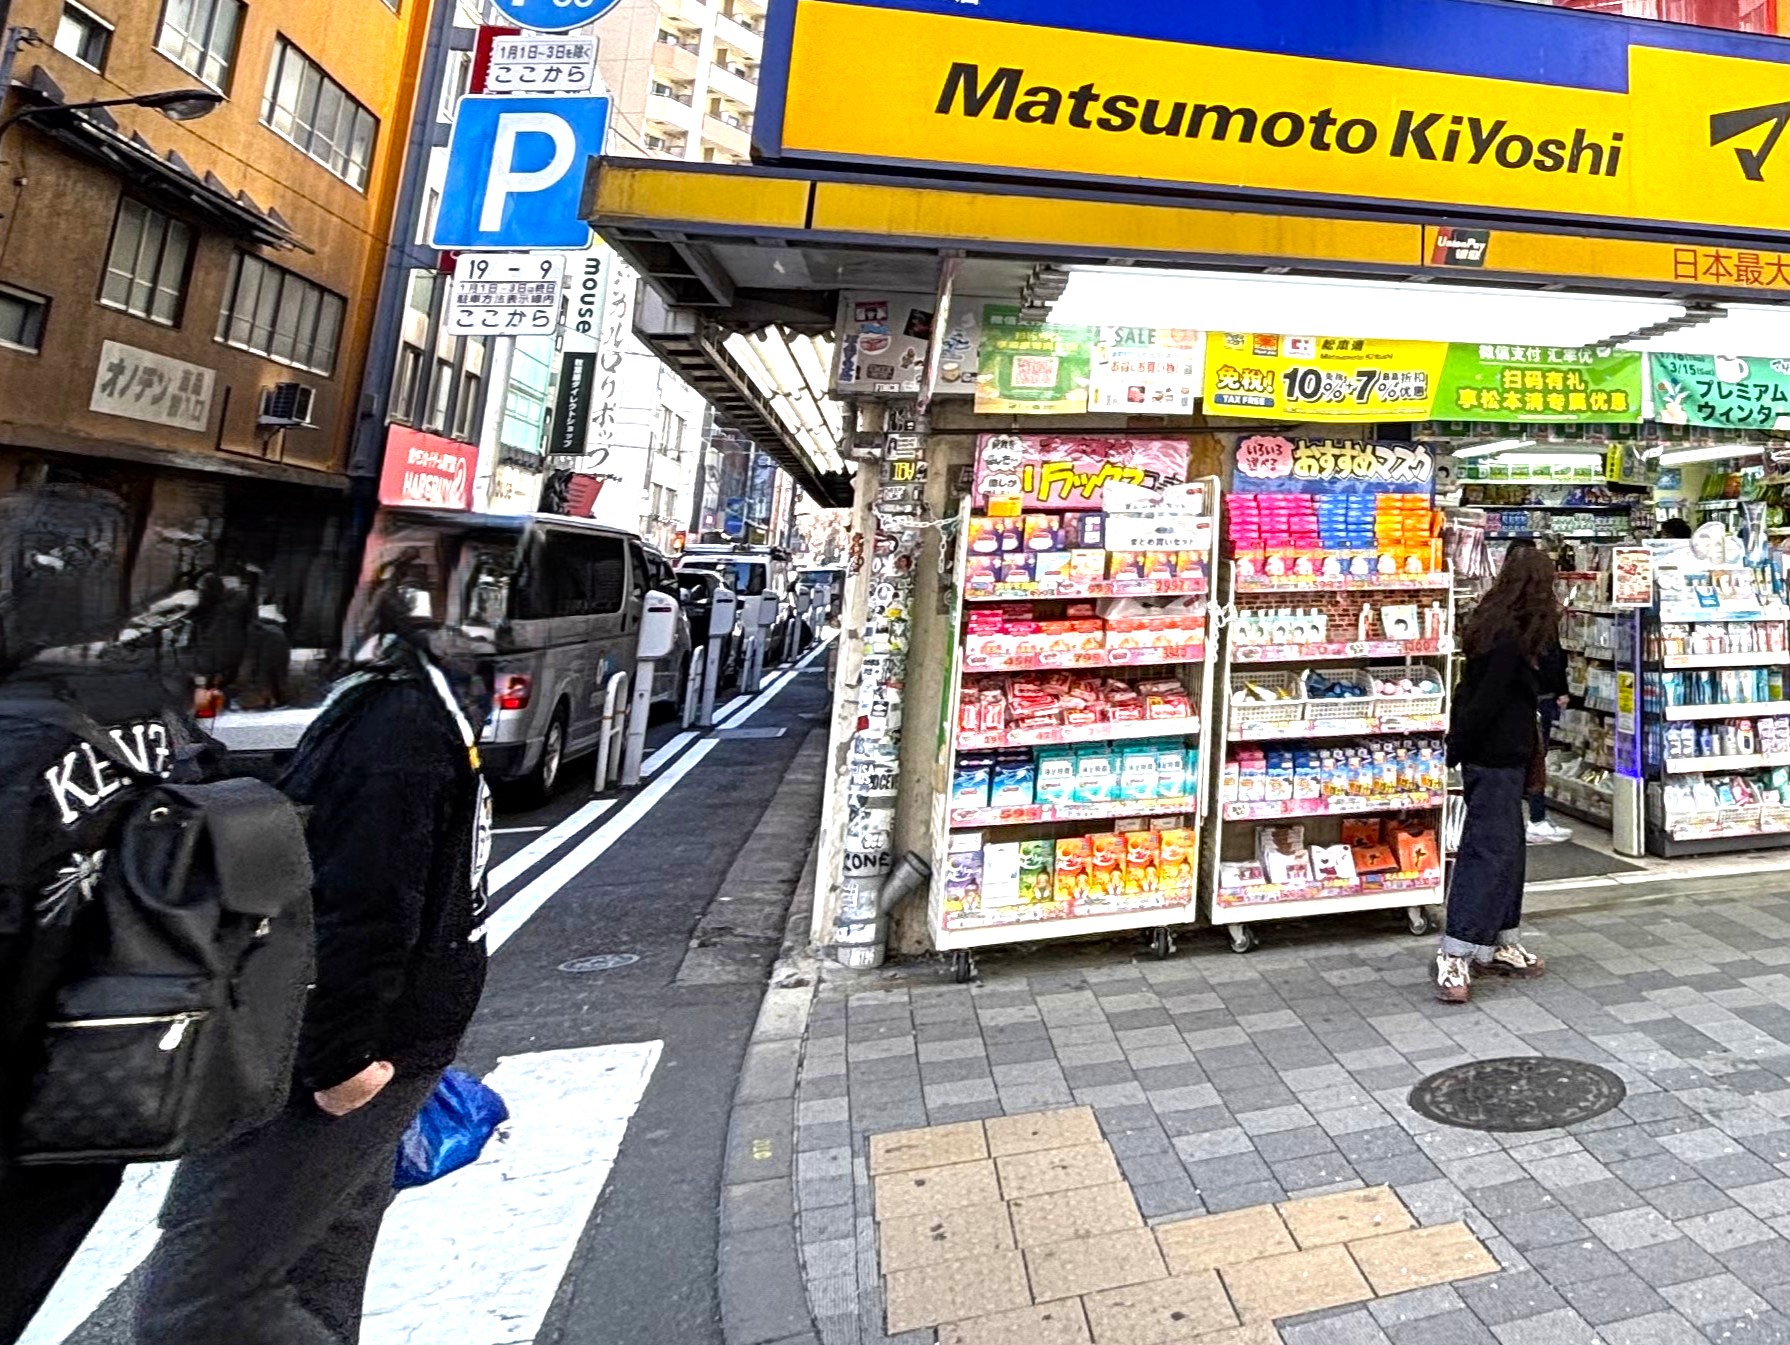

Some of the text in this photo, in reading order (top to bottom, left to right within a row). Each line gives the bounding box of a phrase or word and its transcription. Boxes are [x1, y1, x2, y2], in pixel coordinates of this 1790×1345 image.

[494, 65, 586, 84] ここから
[935, 60, 1624, 179] Matsumoto KiYoshi
[478, 112, 577, 233] P
[469, 260, 489, 279] 19
[540, 260, 552, 279] 9
[576, 257, 600, 334] mouse
[456, 309, 550, 328] ここから
[1696, 380, 1788, 402] プレミアム
[1697, 401, 1790, 424] ウィンター
[1293, 439, 1433, 482] おすすめマスク
